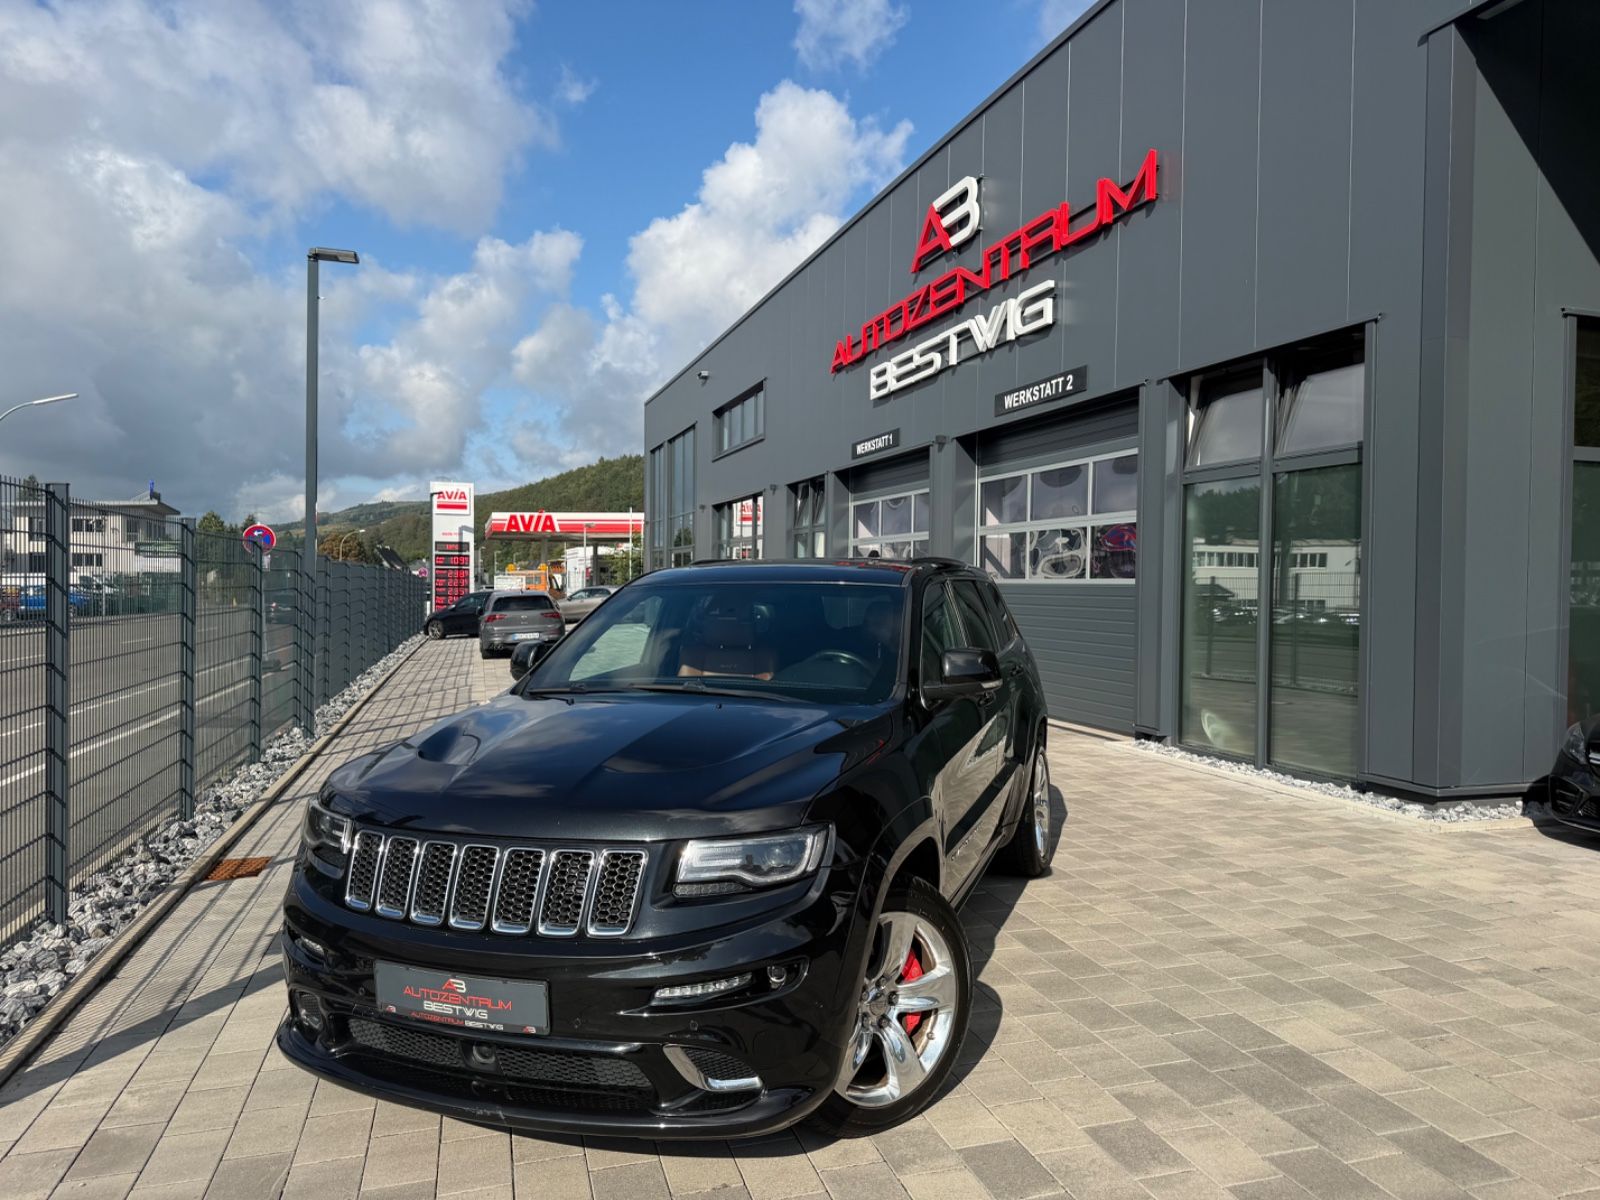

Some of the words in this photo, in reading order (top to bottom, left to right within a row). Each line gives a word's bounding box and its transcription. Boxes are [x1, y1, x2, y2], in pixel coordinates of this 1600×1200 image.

[830, 148, 1158, 373] AUTOZENTRUM
[869, 279, 1055, 400] BESTWIG
[1004, 376, 1065, 410] WERKSTATT
[1065, 374, 1074, 391] 2
[856, 434, 889, 456] WERKSTATT
[437, 488, 467, 500] AVIA
[506, 507, 557, 532] AVIA
[403, 985, 513, 1011] AUTOZENTRUM
[423, 1000, 489, 1020] BESTWIG
[410, 1011, 465, 1026] AUTOZENTRUM
[464, 1020, 504, 1031] BESTWIG
